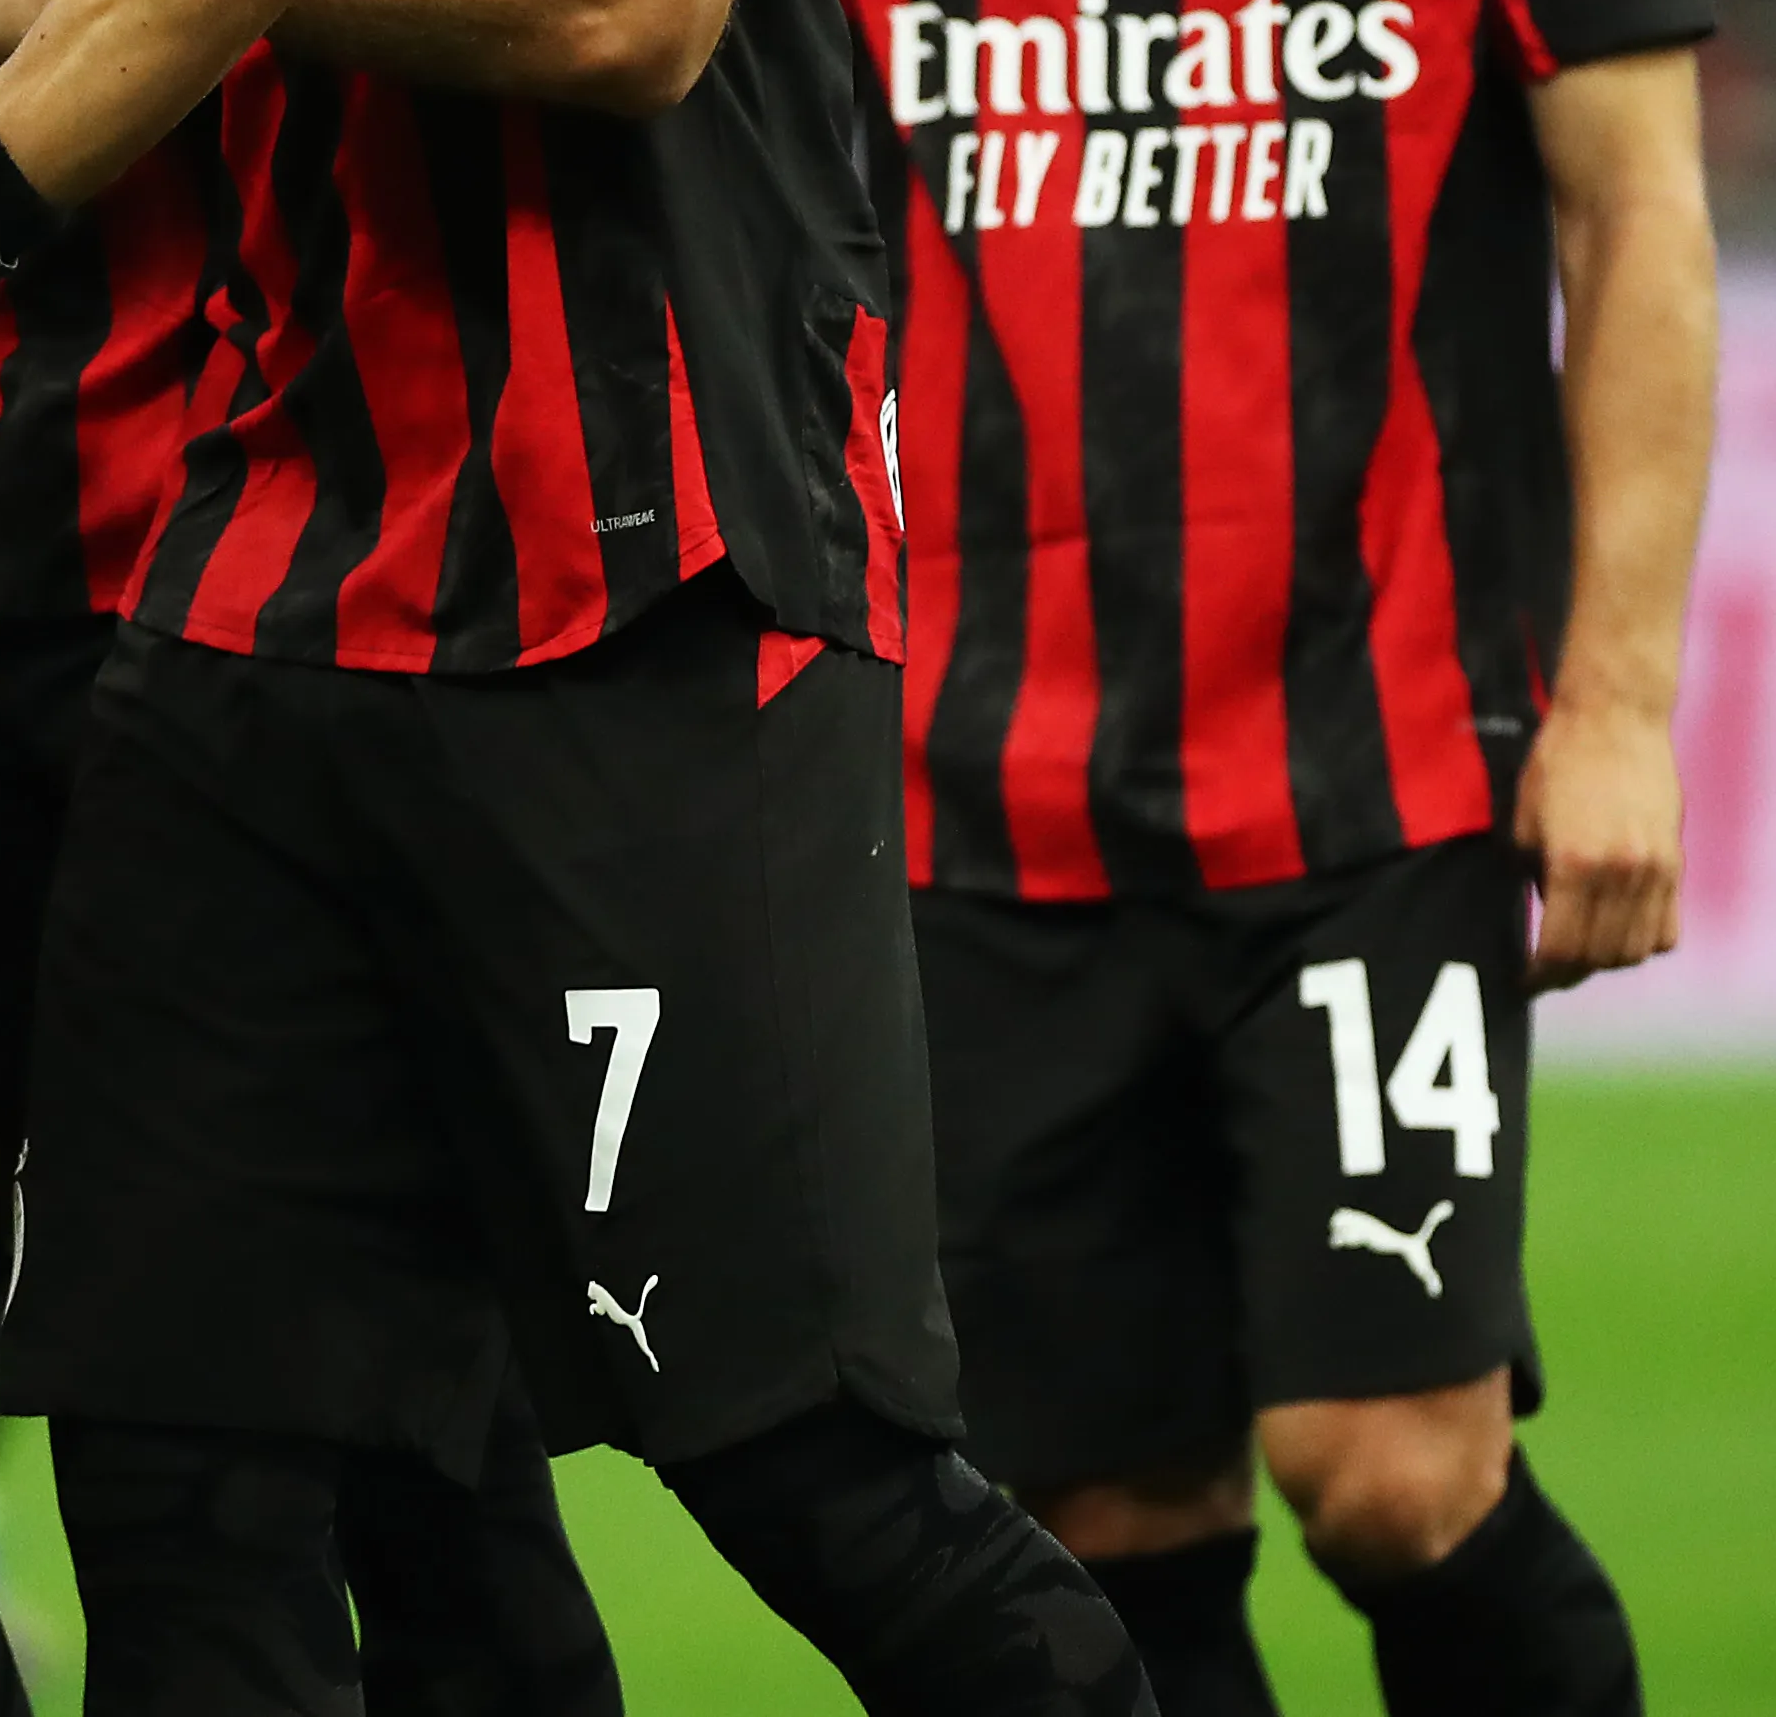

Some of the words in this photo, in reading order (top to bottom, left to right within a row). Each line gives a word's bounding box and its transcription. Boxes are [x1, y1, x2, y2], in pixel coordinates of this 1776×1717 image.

[944, 128, 1062, 235] FLY
[1072, 117, 1334, 229] BETTER
[564, 987, 661, 1213] 7
[1297, 956, 1502, 1180] 14
